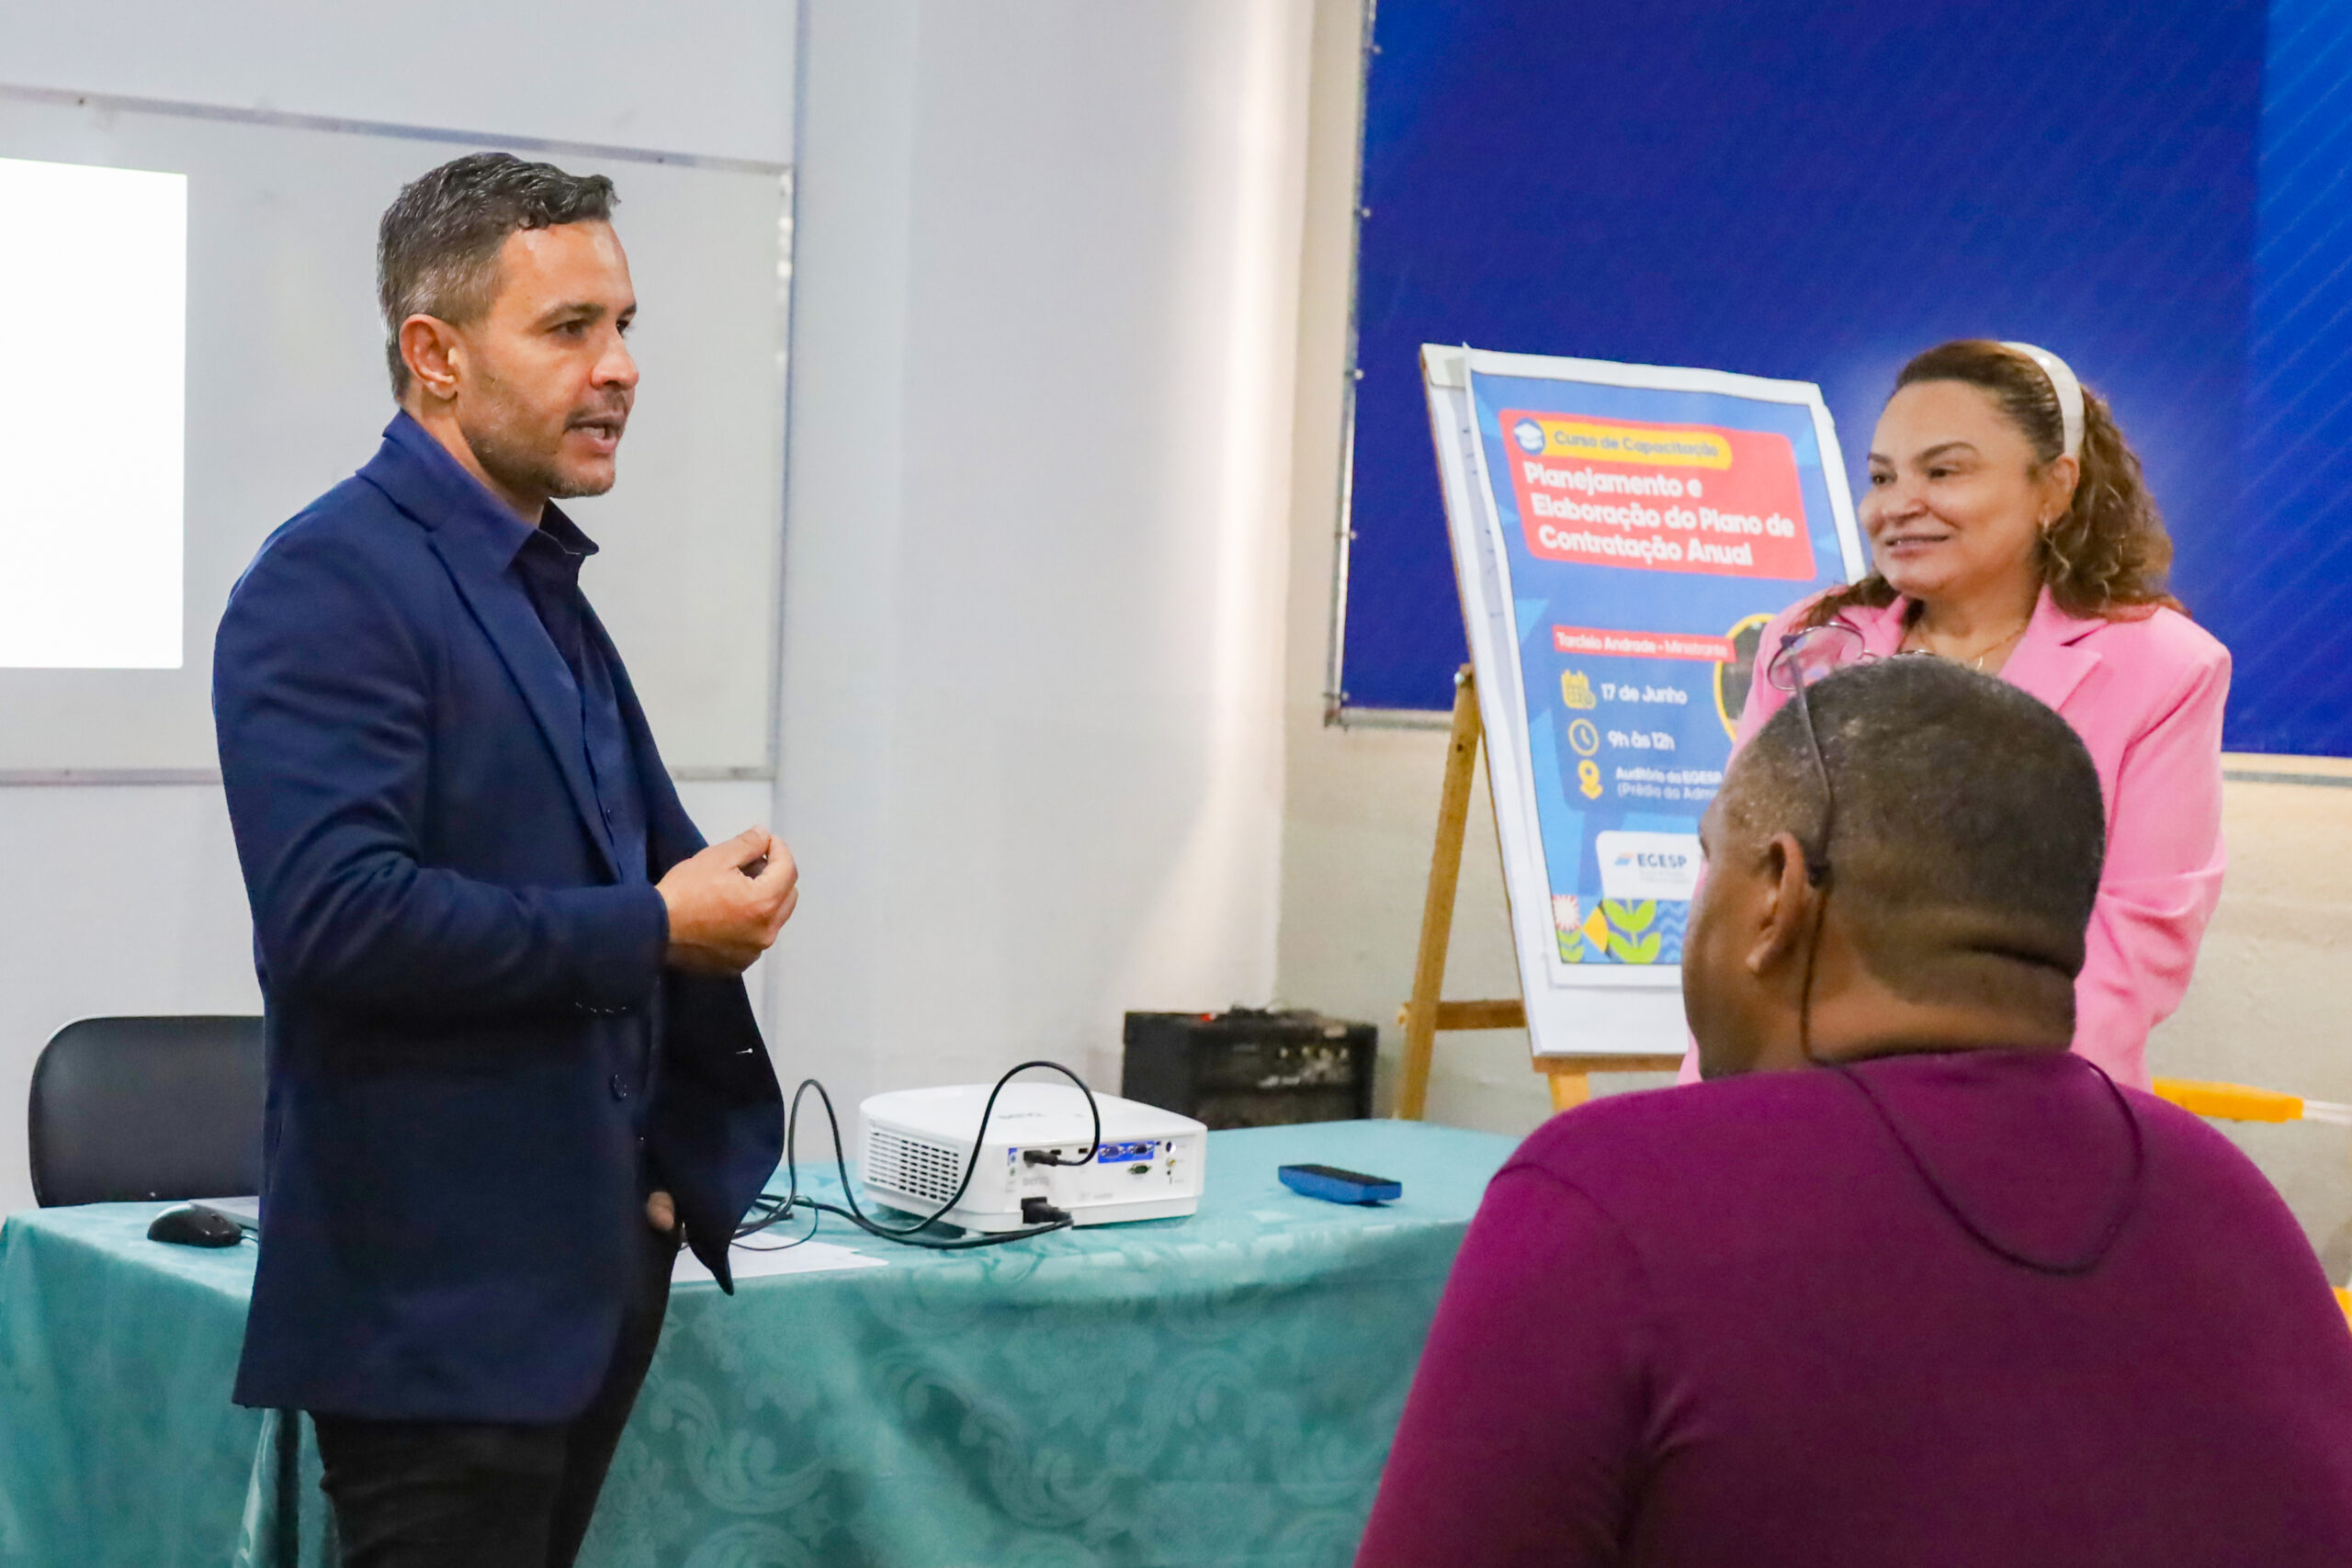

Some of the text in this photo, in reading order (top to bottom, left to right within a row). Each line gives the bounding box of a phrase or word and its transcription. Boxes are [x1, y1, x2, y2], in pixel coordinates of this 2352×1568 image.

[1554, 430, 1719, 457] Curso de Capacitação
[1522, 461, 1702, 498] Planejamento e
[1530, 492, 1795, 537] Elaboração do Plano de
[1537, 525, 1753, 565] Contratação Anual
[1603, 636, 1657, 654] Andrade
[1600, 683, 1689, 705] 17 de Junho
[1607, 730, 1676, 750] 9h às 12h
